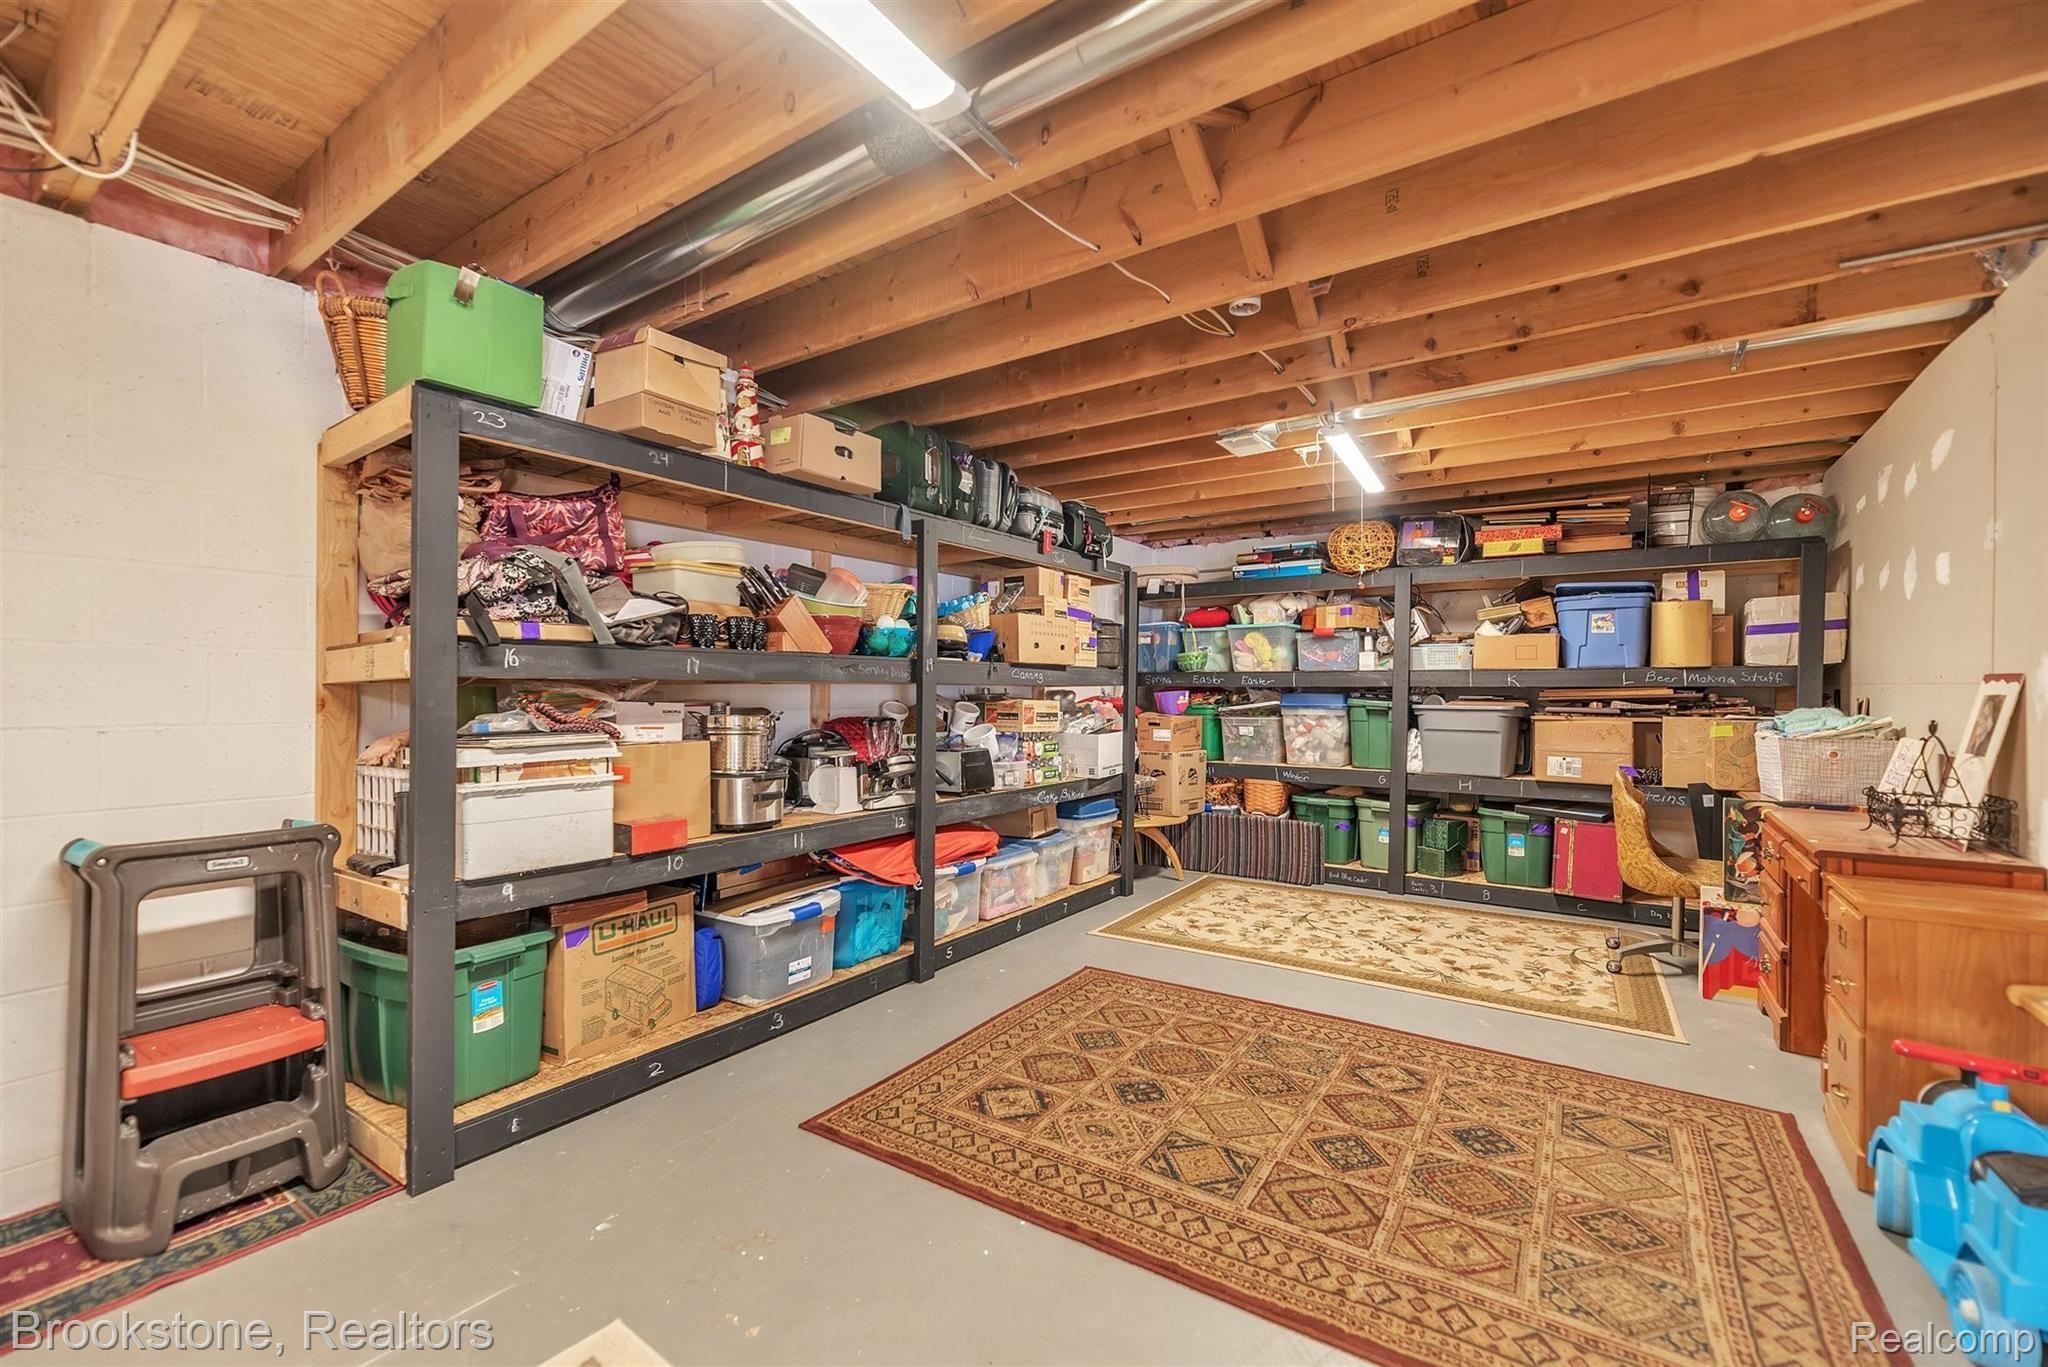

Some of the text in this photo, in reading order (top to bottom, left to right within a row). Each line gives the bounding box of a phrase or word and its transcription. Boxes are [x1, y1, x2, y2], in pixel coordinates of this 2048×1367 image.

[577, 352, 591, 382] PHILIPS
[473, 411, 507, 428] 23
[649, 452, 669, 467] 24
[504, 648, 520, 668] 16
[1241, 674, 1275, 685] Easter
[1507, 674, 1520, 687] K
[1622, 672, 1634, 685] L
[1645, 671, 1677, 683] Beer
[1688, 673, 1736, 685] Making
[1378, 776, 1387, 785] G
[1458, 780, 1472, 791] H
[1643, 793, 1686, 806] teins
[895, 816, 906, 829] 12
[667, 855, 684, 872] 10
[502, 883, 514, 903] 9
[598, 907, 674, 941] U-HAUL
[1016, 919, 1022, 933] 6
[946, 946, 954, 959] 5
[769, 1013, 785, 1030] 3
[648, 1062, 665, 1079] 2
